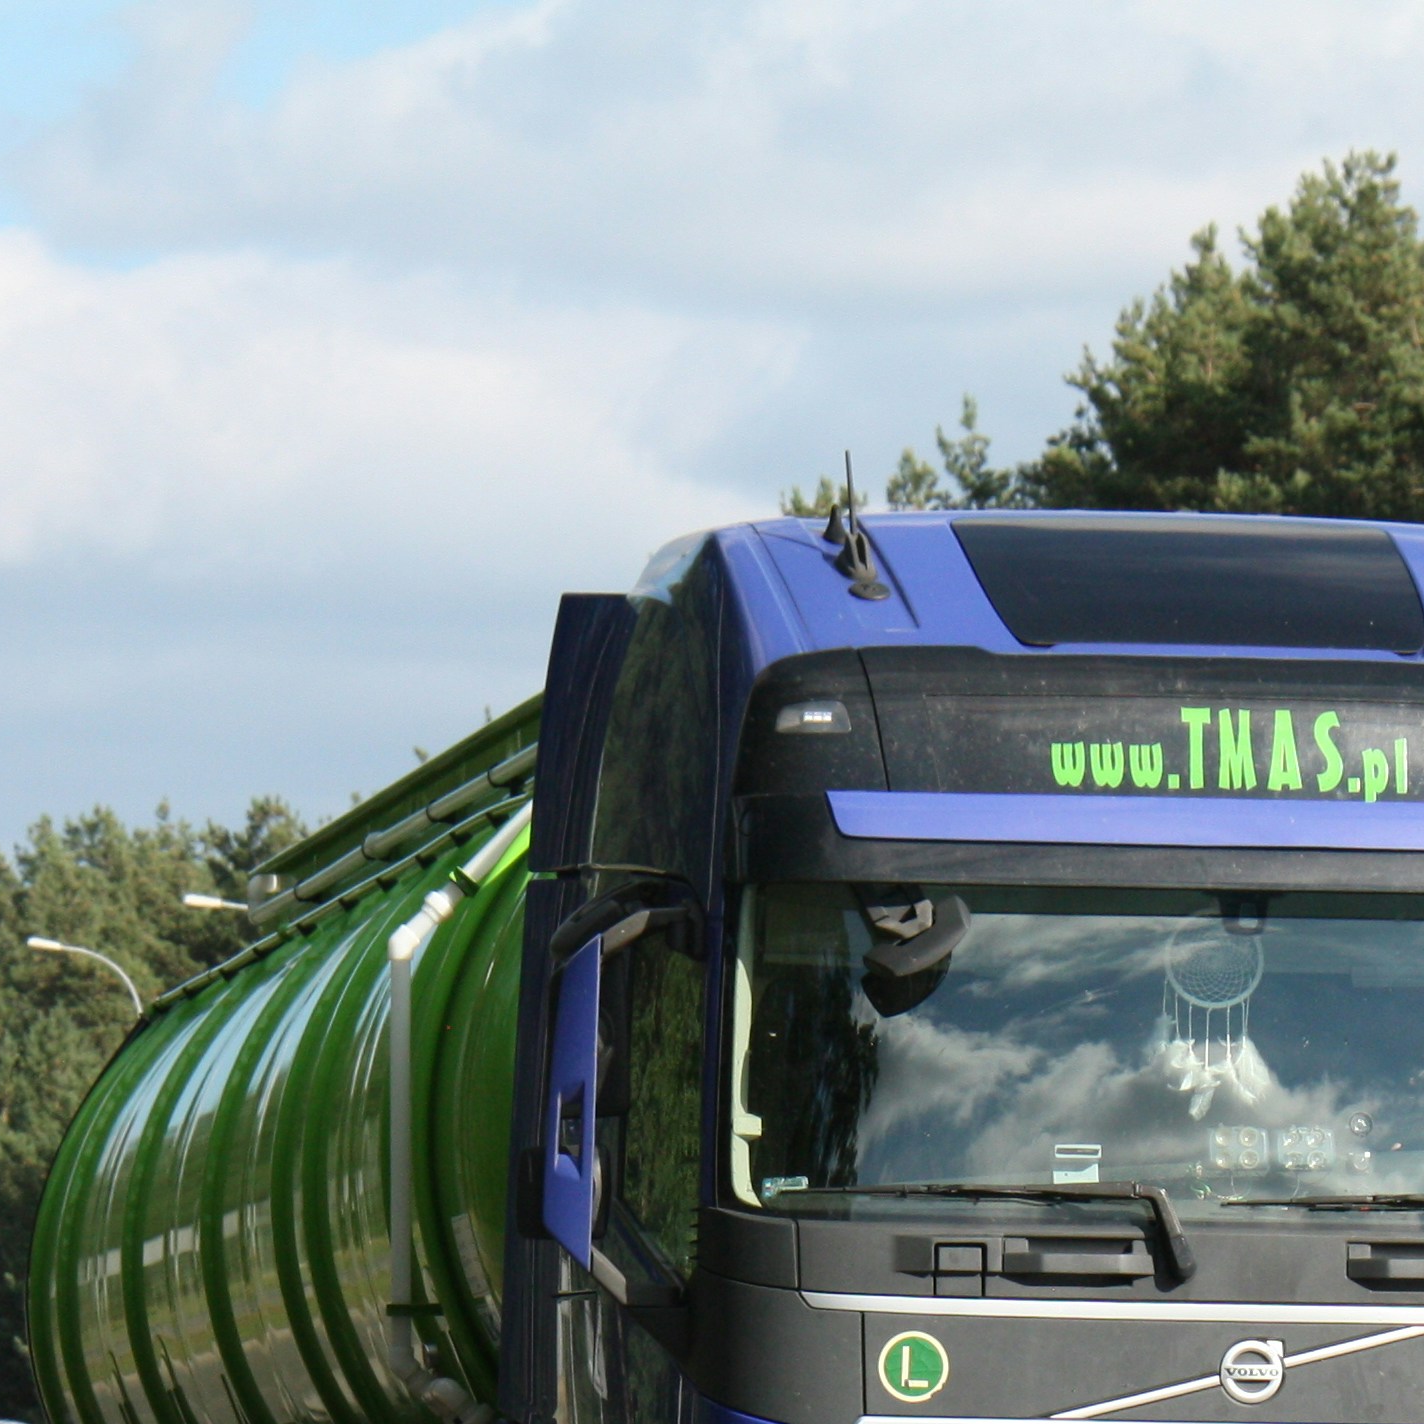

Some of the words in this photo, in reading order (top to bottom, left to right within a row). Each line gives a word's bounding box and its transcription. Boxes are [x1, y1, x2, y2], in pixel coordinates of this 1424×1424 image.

[1051, 706, 1408, 803] www.TMAS.pl
[901, 1345, 929, 1388] L
[1223, 1366, 1279, 1378] VOLVO
